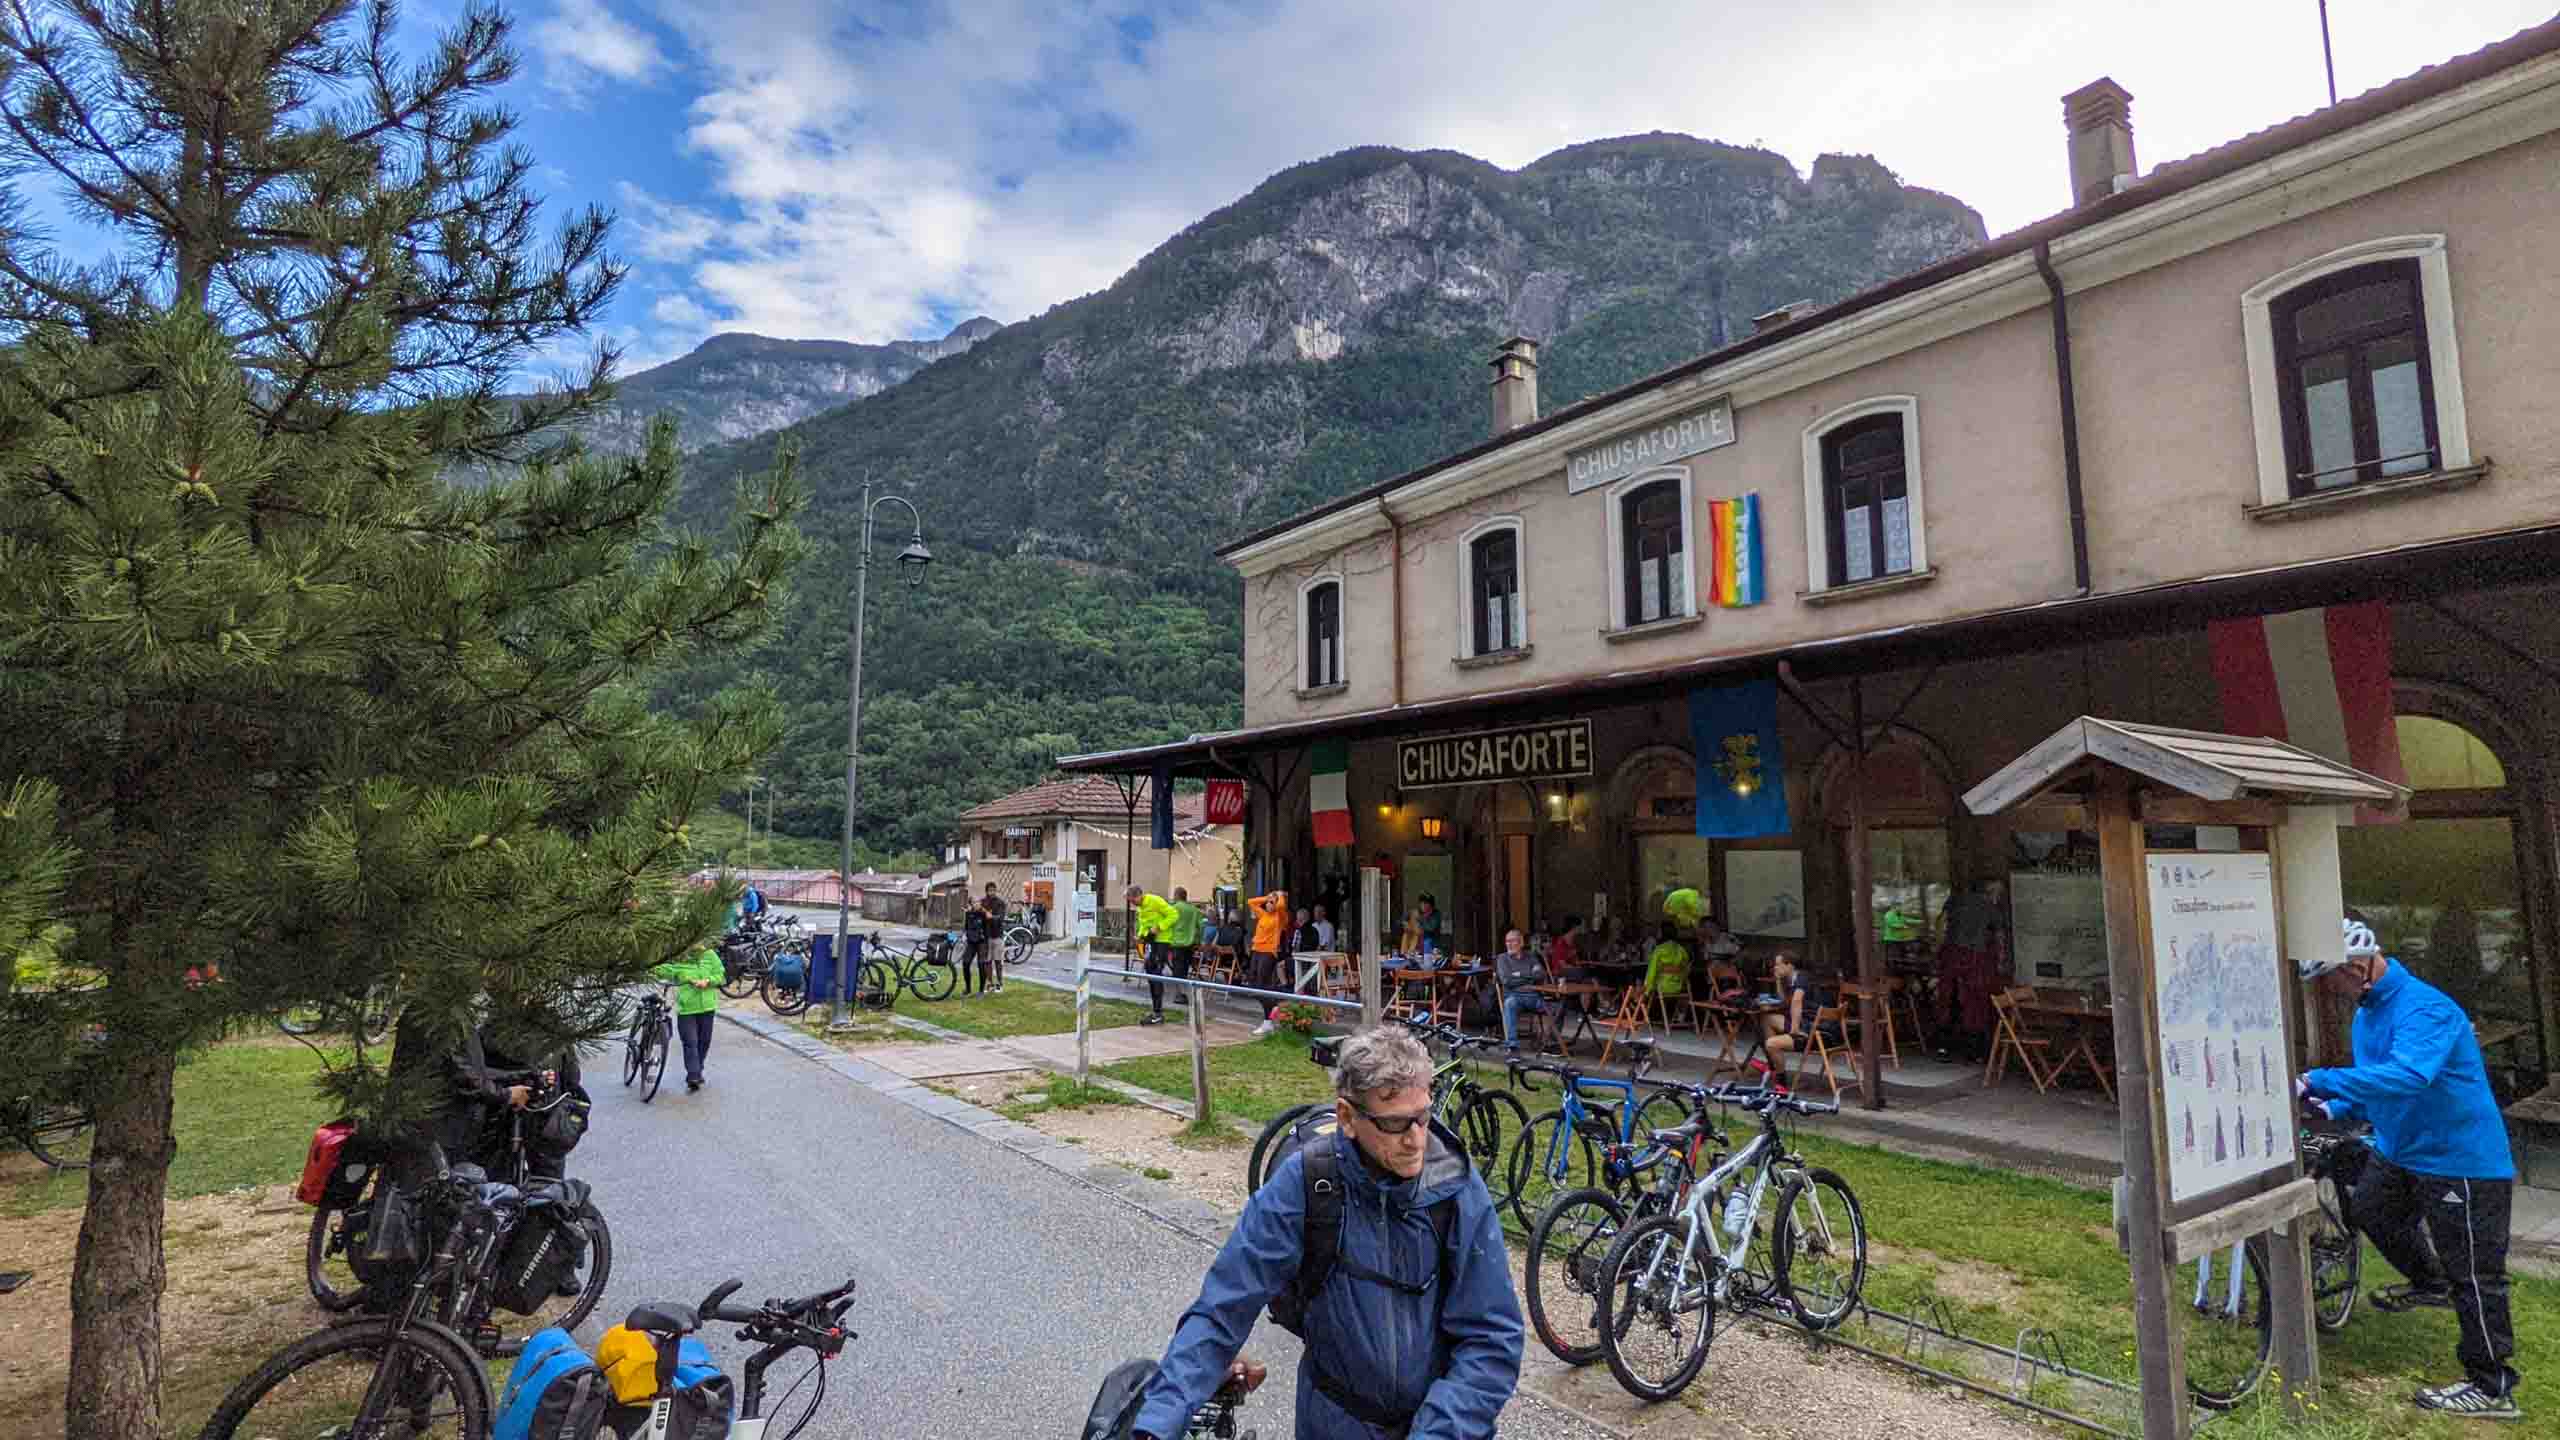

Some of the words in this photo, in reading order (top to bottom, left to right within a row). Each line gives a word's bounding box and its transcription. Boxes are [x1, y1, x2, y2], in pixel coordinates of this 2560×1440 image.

[1574, 408, 1723, 480] CHIUSAFORTE
[1402, 727, 1587, 782] CHIUSAFORTE
[1210, 785, 1243, 818] illy
